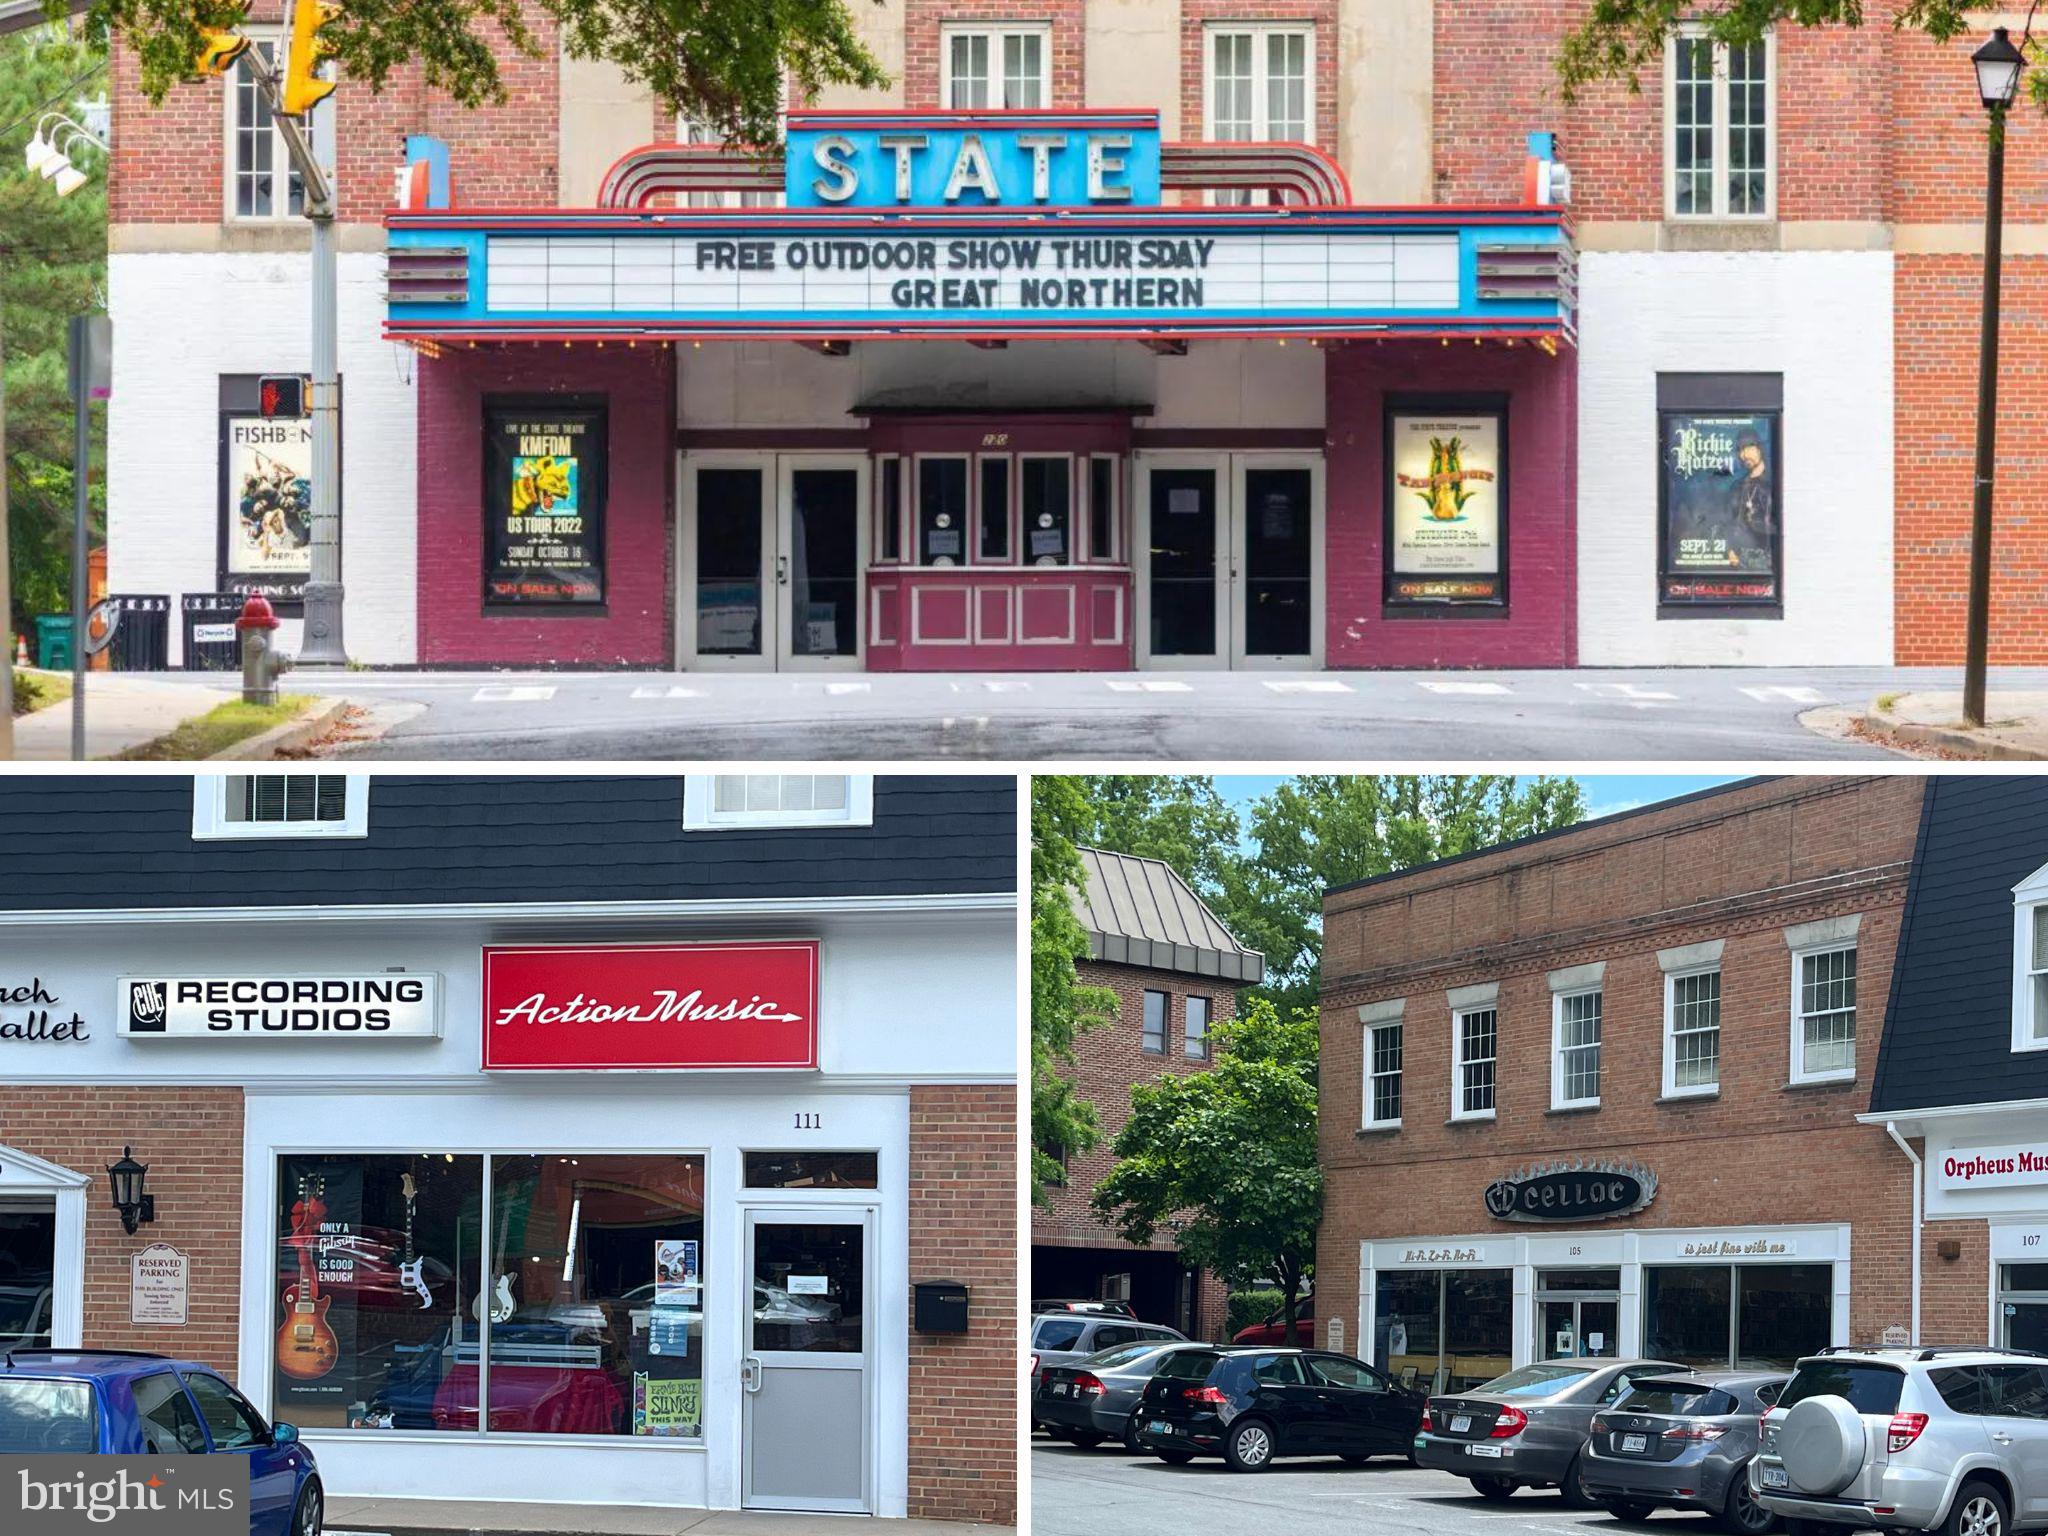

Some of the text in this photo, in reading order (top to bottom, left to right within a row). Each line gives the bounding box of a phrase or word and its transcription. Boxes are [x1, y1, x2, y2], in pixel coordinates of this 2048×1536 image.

[812, 134, 1134, 202] STATE
[697, 240, 1215, 270] FREE OUTDOOR SHOW THURSDAY
[891, 279, 1203, 308] GREAT NORTHERN
[520, 436, 571, 456] KMFDM
[507, 517, 582, 533] US TOUR 2022
[508, 546, 534, 558] SUNDAY
[538, 546, 569, 558] OCTOBER
[1680, 539, 1726, 552] SEPT. 21
[1400, 583, 1420, 594] ON
[1424, 583, 1459, 594] SALE
[177, 980, 424, 1003] RECORDING
[495, 989, 783, 1025] Action Music
[207, 1008, 391, 1032] STUDIOS
[793, 1113, 822, 1129] 111
[1944, 1156, 2014, 1180] Orpheus
[320, 1223, 349, 1233] ONLY A
[319, 1235, 356, 1257] Gibson
[1696, 1241, 1718, 1256] just
[1720, 1241, 1741, 1256] fine
[1744, 1240, 1767, 1254] with
[2023, 1236, 2041, 1246] 107
[1569, 1246, 1581, 1255] 105
[139, 1259, 181, 1267] RESERVED
[319, 1259, 353, 1270] IS GOOD
[140, 1269, 180, 1277] PARKING
[319, 1271, 353, 1282] ENOUGH
[650, 1396, 696, 1415] SLINKY
